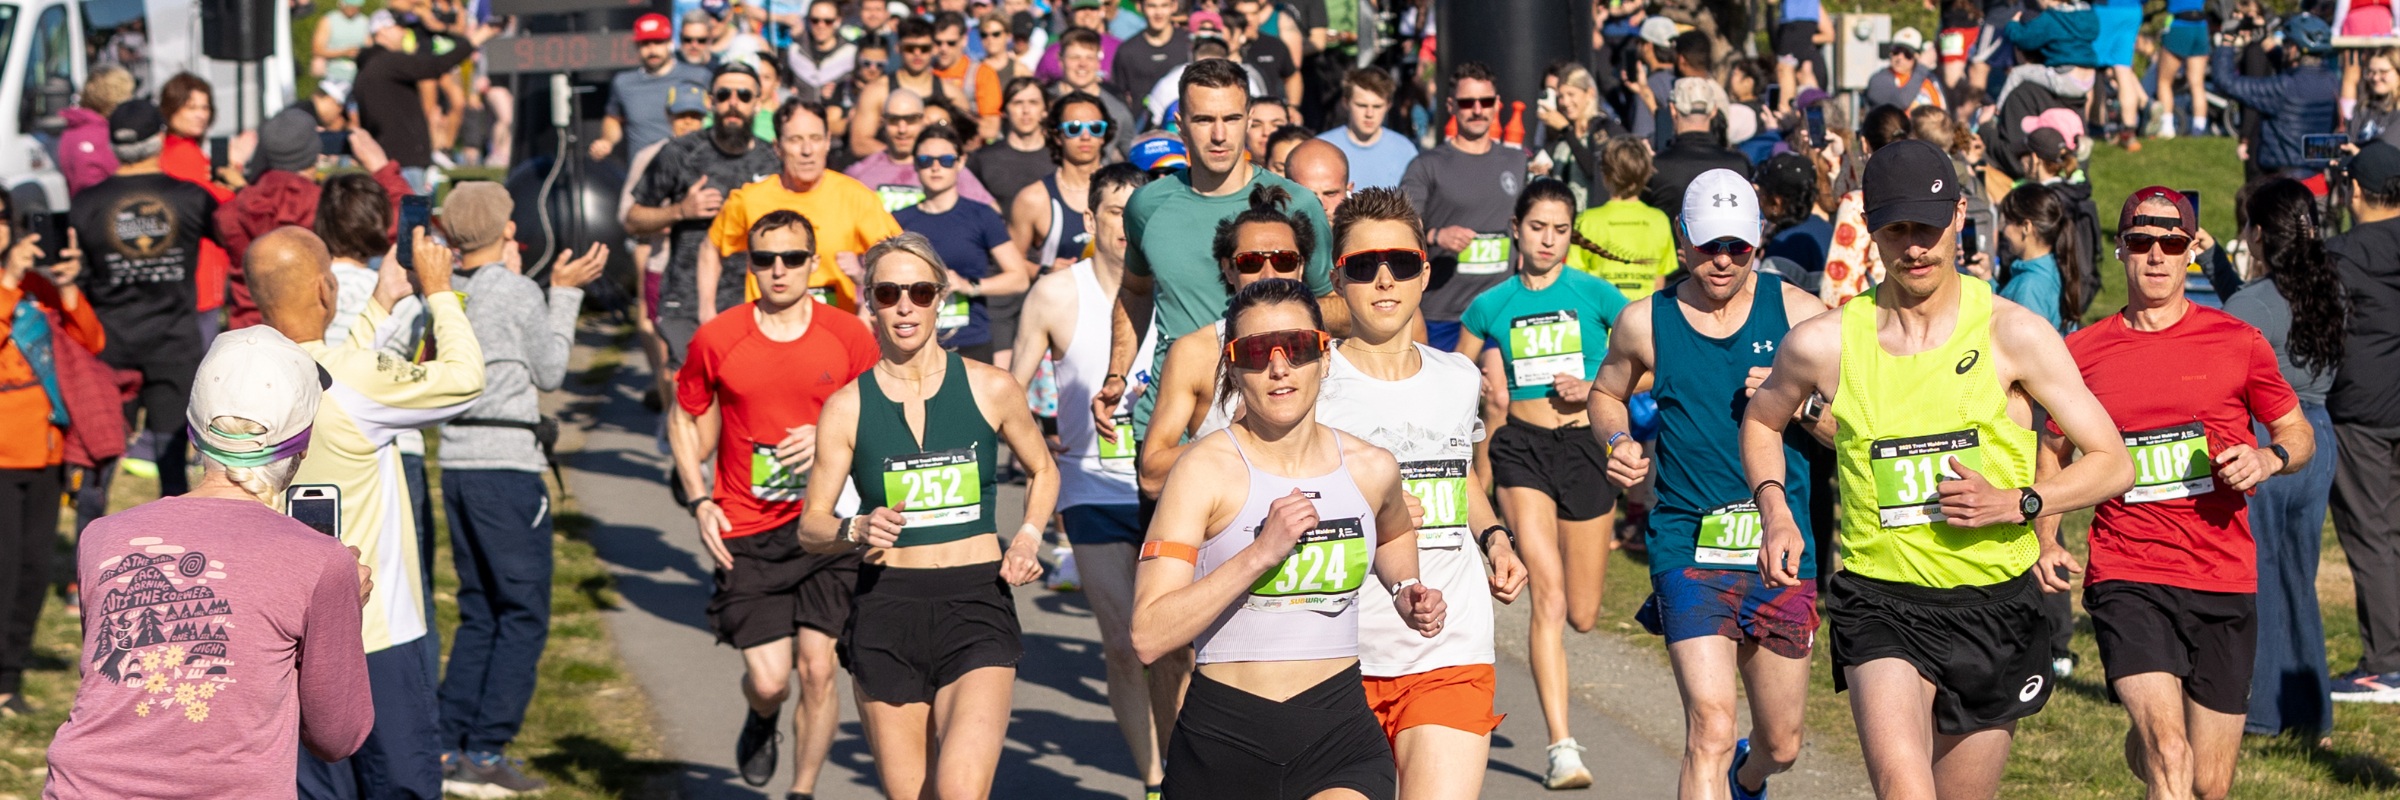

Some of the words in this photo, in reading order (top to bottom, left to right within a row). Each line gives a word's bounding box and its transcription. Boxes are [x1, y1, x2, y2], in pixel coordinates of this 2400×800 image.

[1470, 240, 1501, 262] 126
[1523, 324, 1566, 356] 347
[2137, 443, 2191, 482] 108
[902, 467, 964, 508] 252
[1402, 480, 1456, 524] 30
[1916, 507, 1941, 516] SUBW
[1716, 514, 1763, 547] 302
[118, 558, 132, 573] ON
[132, 556, 150, 567] THE
[134, 568, 161, 582] EACH
[1275, 543, 1348, 593] 324
[127, 580, 171, 595] MORNING
[102, 593, 131, 614] CUTS
[134, 591, 161, 605] THE
[162, 587, 211, 602] COBWEBS
[208, 605, 229, 614] ONLY
[119, 622, 130, 647] THE
[145, 610, 154, 644] TRAIL
[171, 632, 189, 641] ONE
[193, 643, 225, 655] NIGHT
